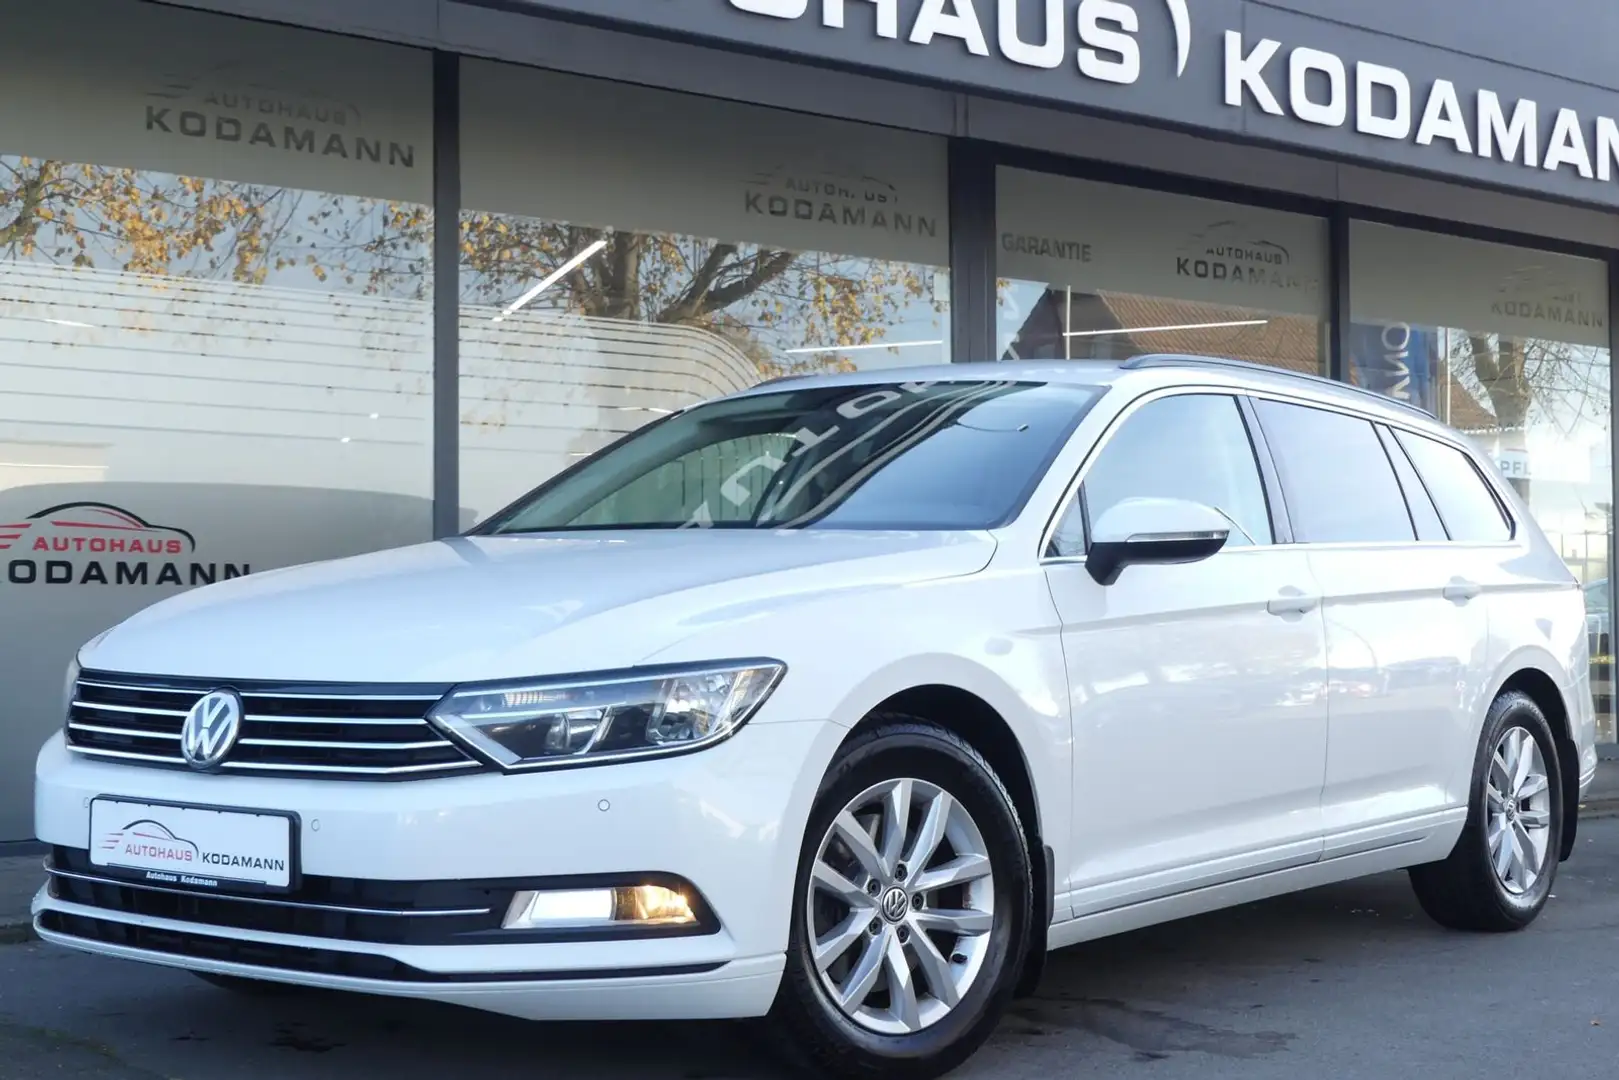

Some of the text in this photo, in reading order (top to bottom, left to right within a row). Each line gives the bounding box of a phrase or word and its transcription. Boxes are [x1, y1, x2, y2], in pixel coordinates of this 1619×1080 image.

[145, 105, 415, 168] KODAMANN
[745, 190, 937, 237] KODAMANN
[1001, 232, 1093, 263] GARANTIE
[32, 536, 182, 554] AUTOHAUS
[0, 559, 251, 585] ODAMANN
[124, 843, 285, 872] AUTOHAUS KODAMANN
[146, 871, 218, 887] Autohaus Kodamann
